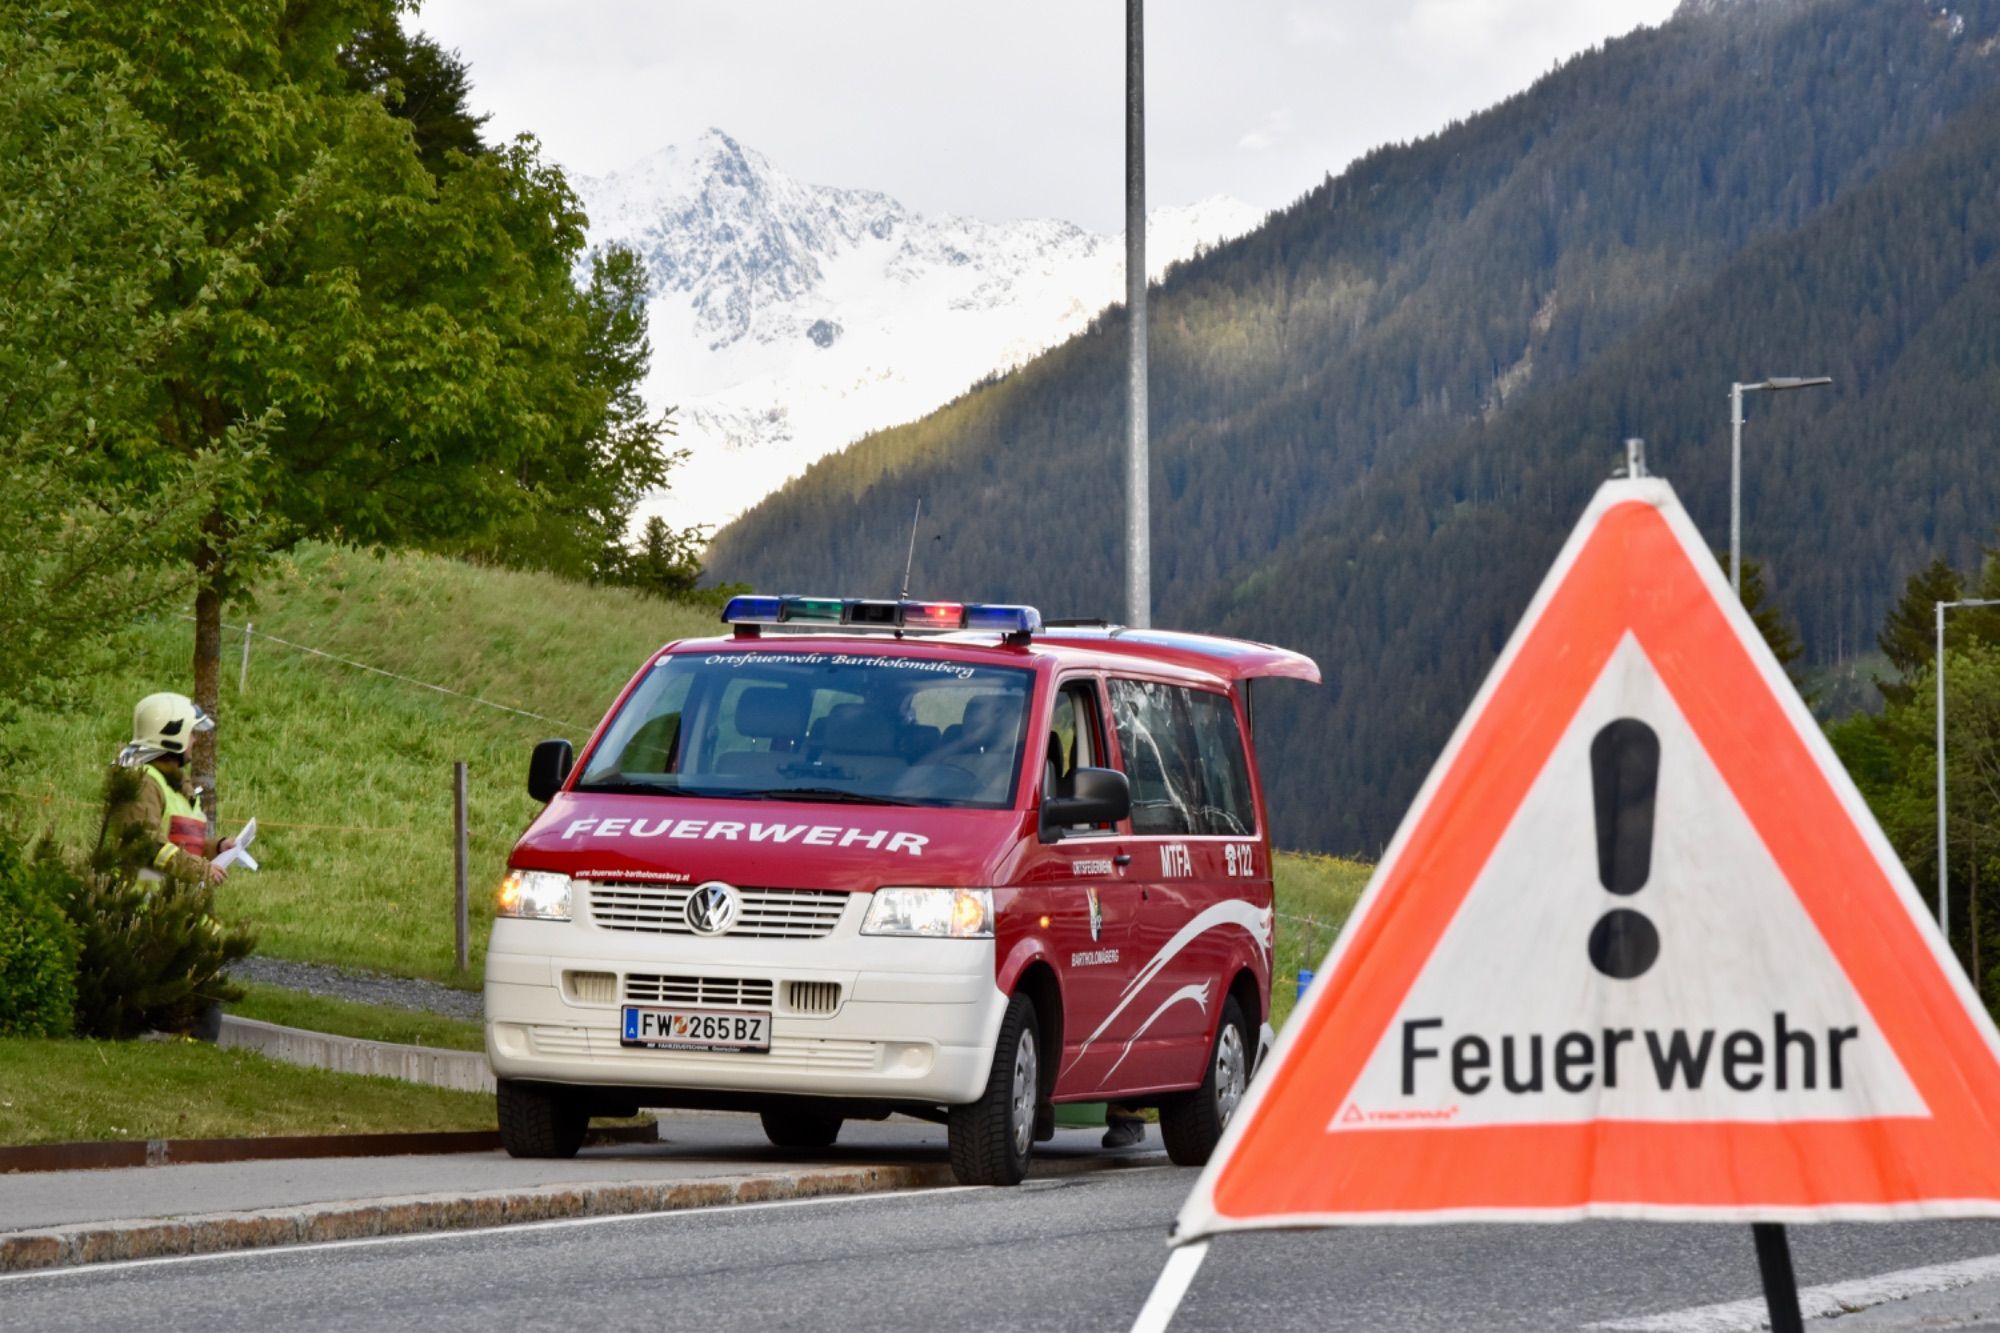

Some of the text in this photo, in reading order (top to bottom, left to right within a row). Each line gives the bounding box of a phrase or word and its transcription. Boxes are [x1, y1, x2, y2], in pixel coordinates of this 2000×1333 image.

[704, 652, 975, 679] Ortsfeuerwehr Bartholomäberg
[561, 818, 929, 856] FEUERWEHR
[1160, 845, 1192, 877] MTFA
[642, 1014, 672, 1037] FW
[1401, 1011, 1858, 1096] Feuerwehr
